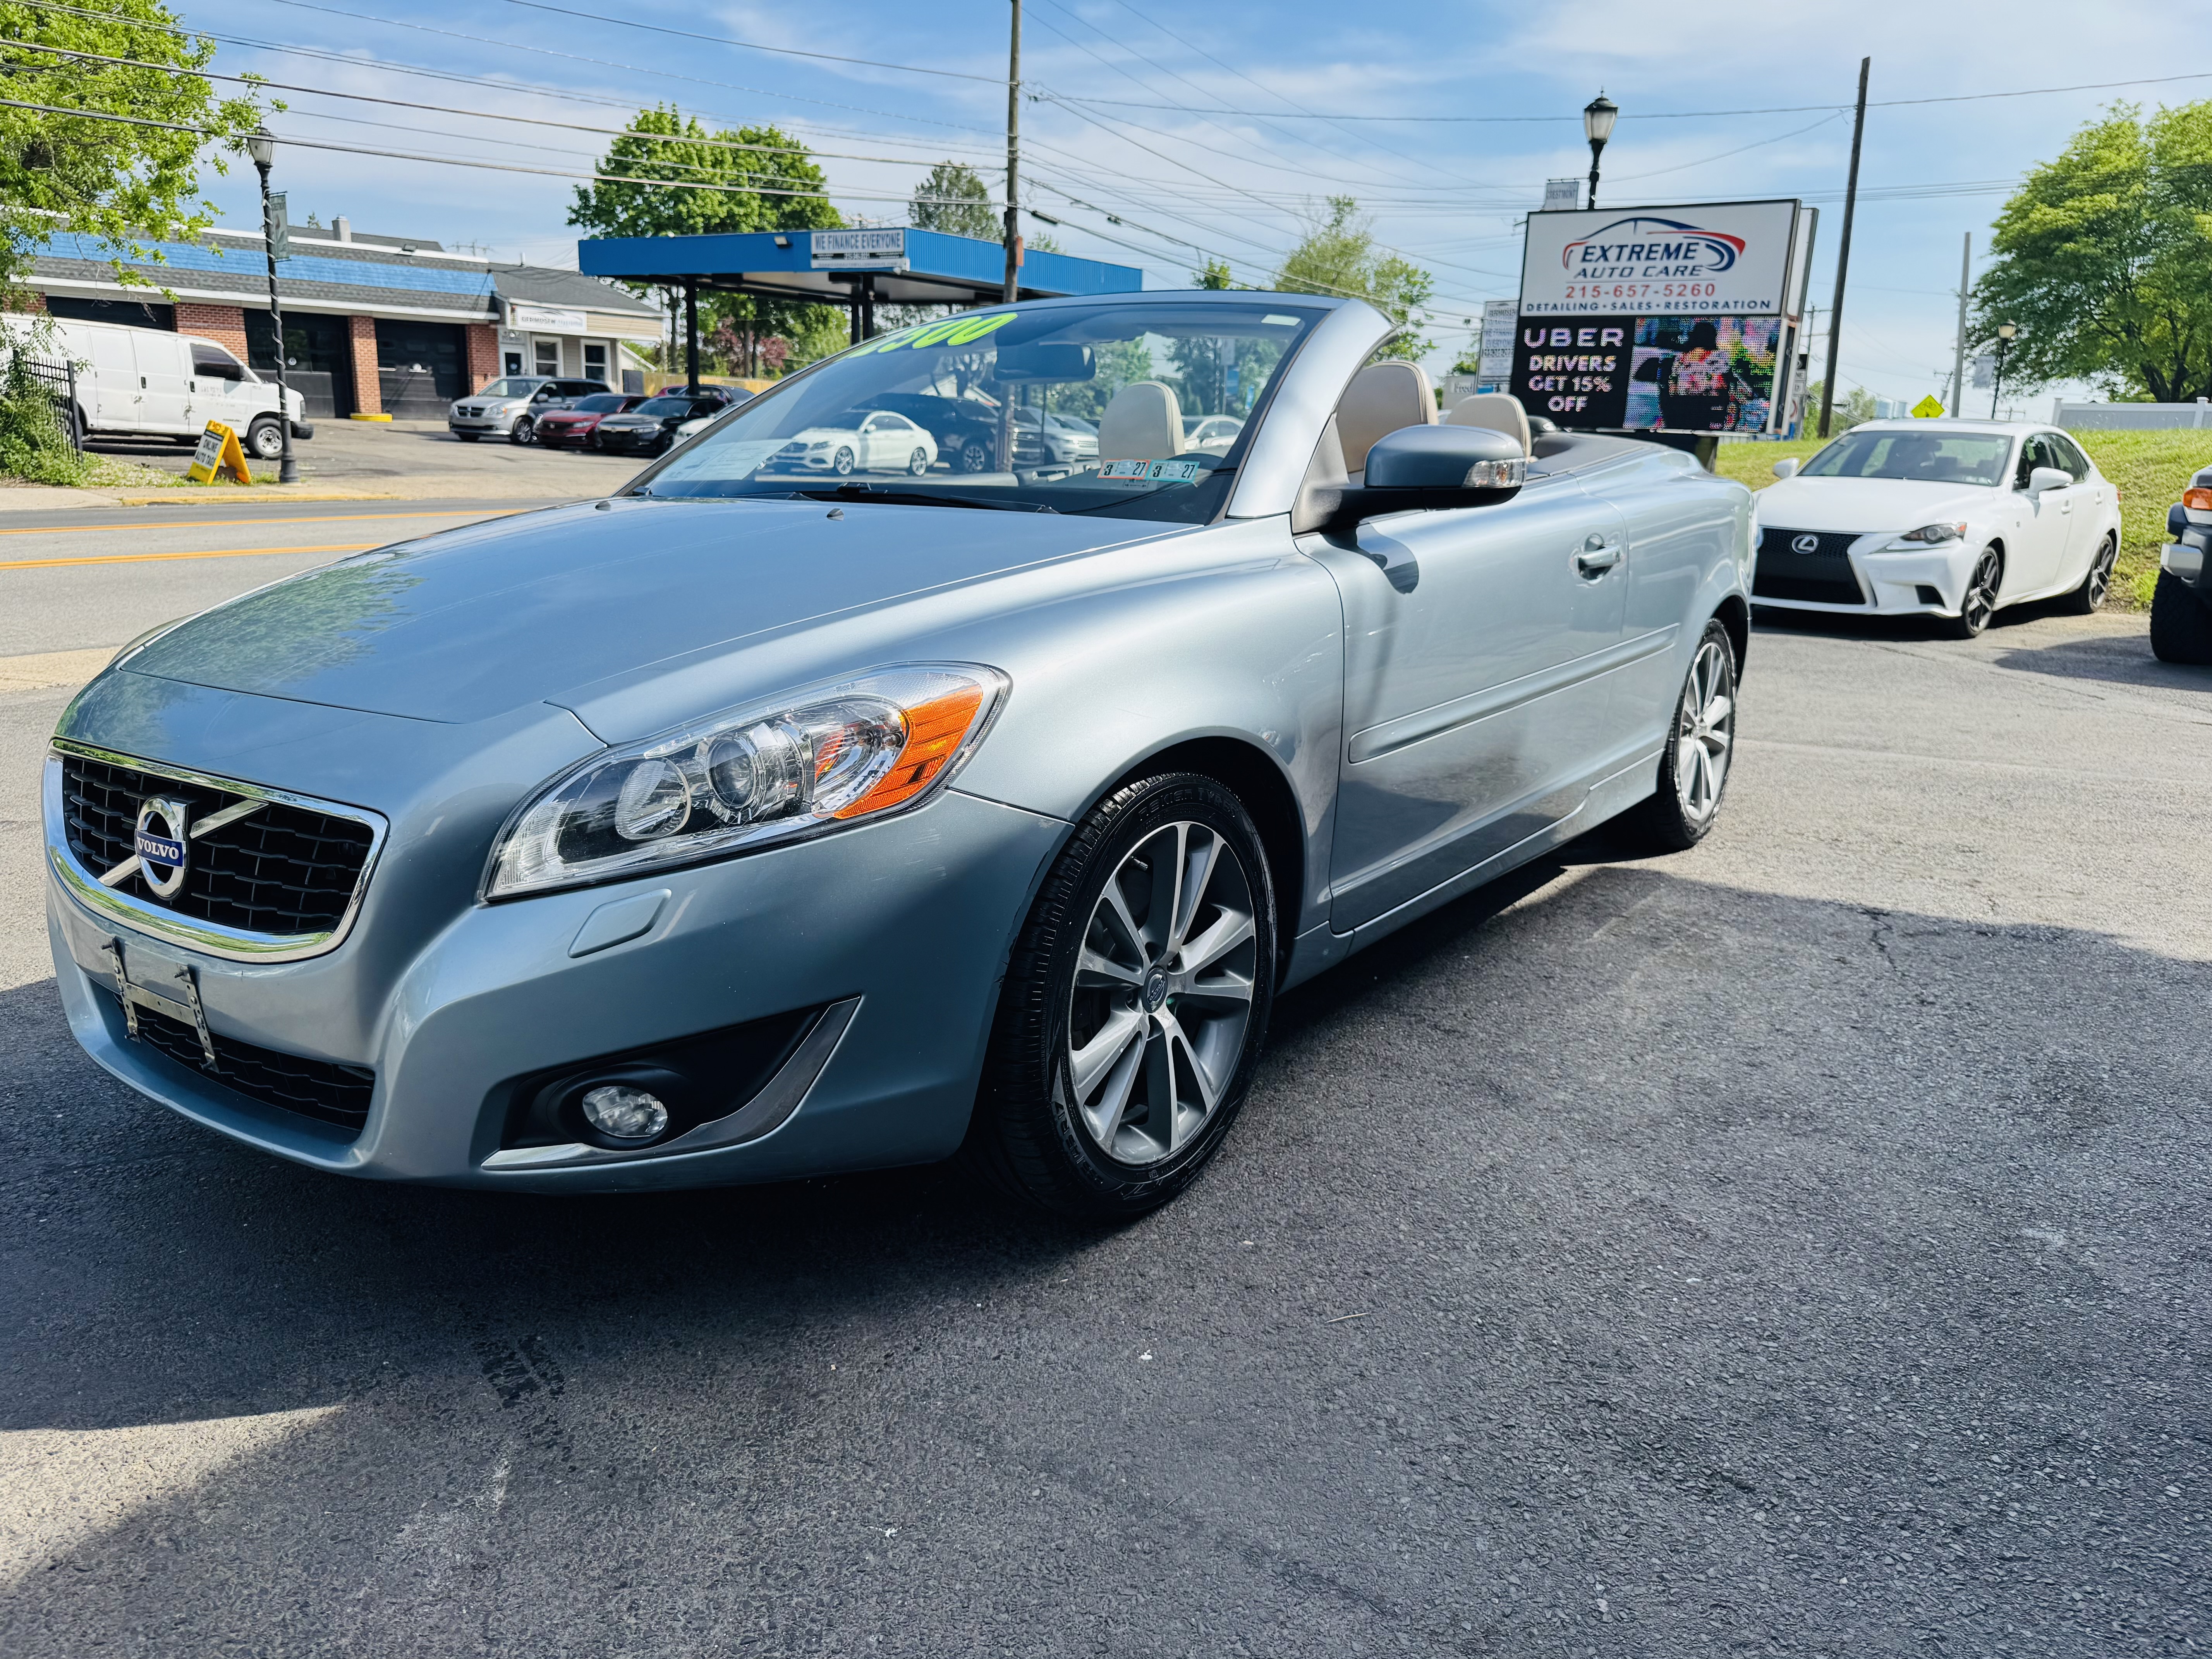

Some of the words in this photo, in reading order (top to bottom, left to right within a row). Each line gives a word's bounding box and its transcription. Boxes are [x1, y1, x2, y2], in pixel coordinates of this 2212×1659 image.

[816, 235, 826, 250] WE
[828, 234, 859, 249] FINANCE
[862, 233, 900, 249] EVERYONE
[1580, 242, 1699, 263] EXTREME
[1573, 267, 1634, 279] AUTO
[1642, 265, 1703, 277] CARE
[1565, 283, 1715, 298] 215-657-5260
[1527, 302, 1599, 311] DETAILING
[1610, 302, 1651, 310] SALES
[1664, 300, 1771, 310] RESTORATION
[1524, 328, 1624, 348] UBER
[1529, 355, 1616, 371] DRIVERS
[1528, 375, 1568, 391] GET
[1572, 376, 1613, 392] 15%
[1547, 395, 1588, 412] OFF
[1104, 465, 1113, 476] 3
[1132, 462, 1146, 476] 27
[1153, 466, 1162, 477] 3
[1181, 464, 1195, 479] 27
[137, 836, 179, 859] VOLVO
